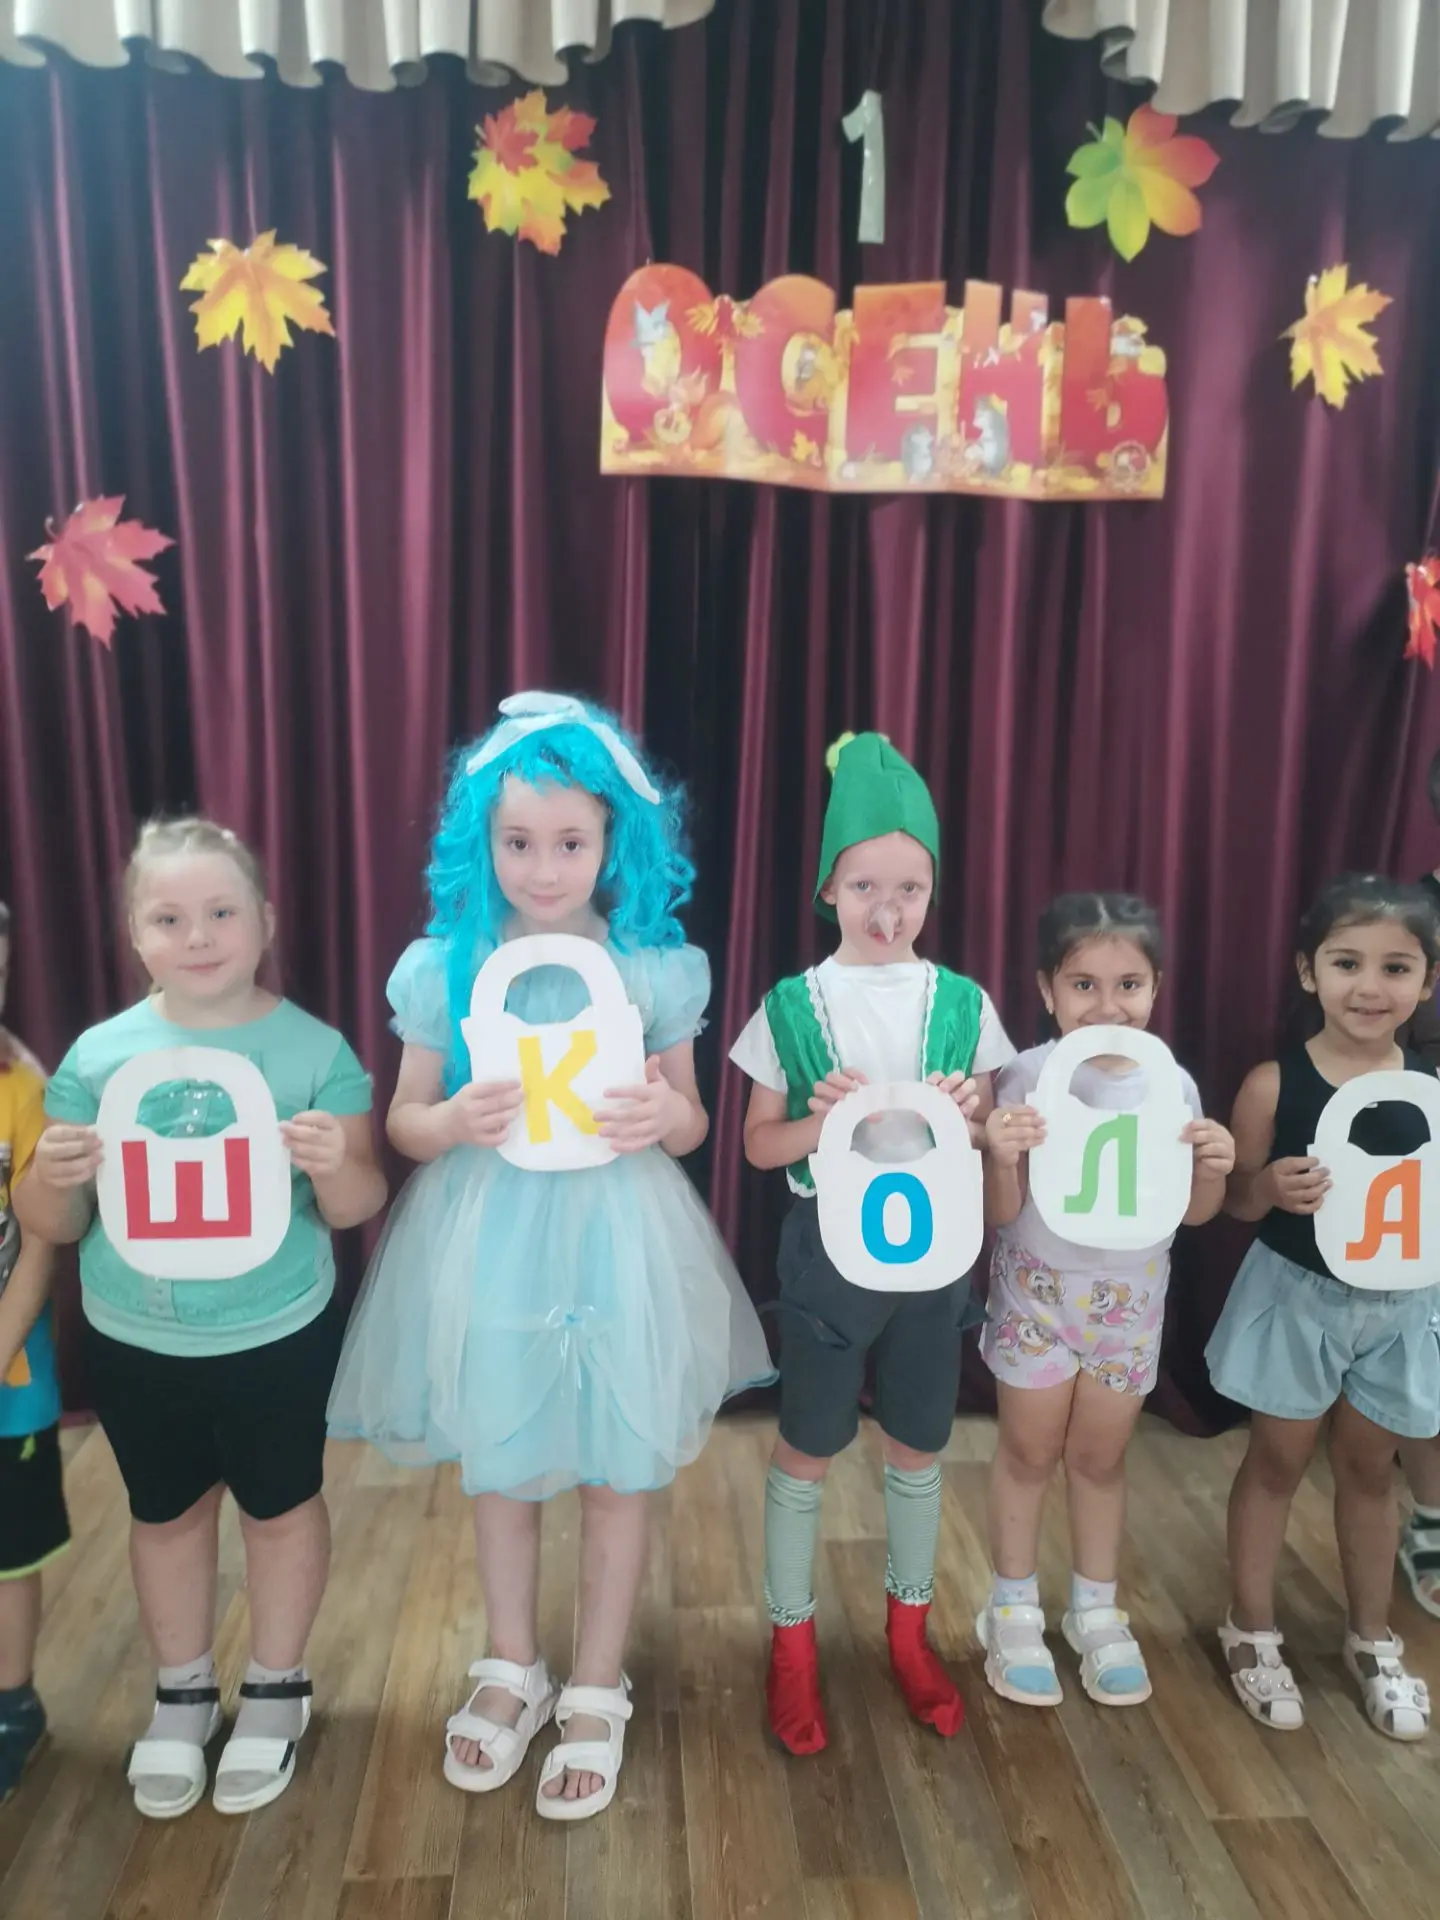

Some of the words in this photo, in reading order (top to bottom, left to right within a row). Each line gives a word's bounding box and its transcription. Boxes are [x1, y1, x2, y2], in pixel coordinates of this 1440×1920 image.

[842, 89, 885, 244] 1
[603, 264, 1168, 482] ОСЕНЬ
[517, 1029, 602, 1144] К
[121, 1138, 252, 1240] Ш
[1064, 1114, 1138, 1216] Л
[1346, 1160, 1422, 1260] А
[862, 1172, 933, 1264] О
